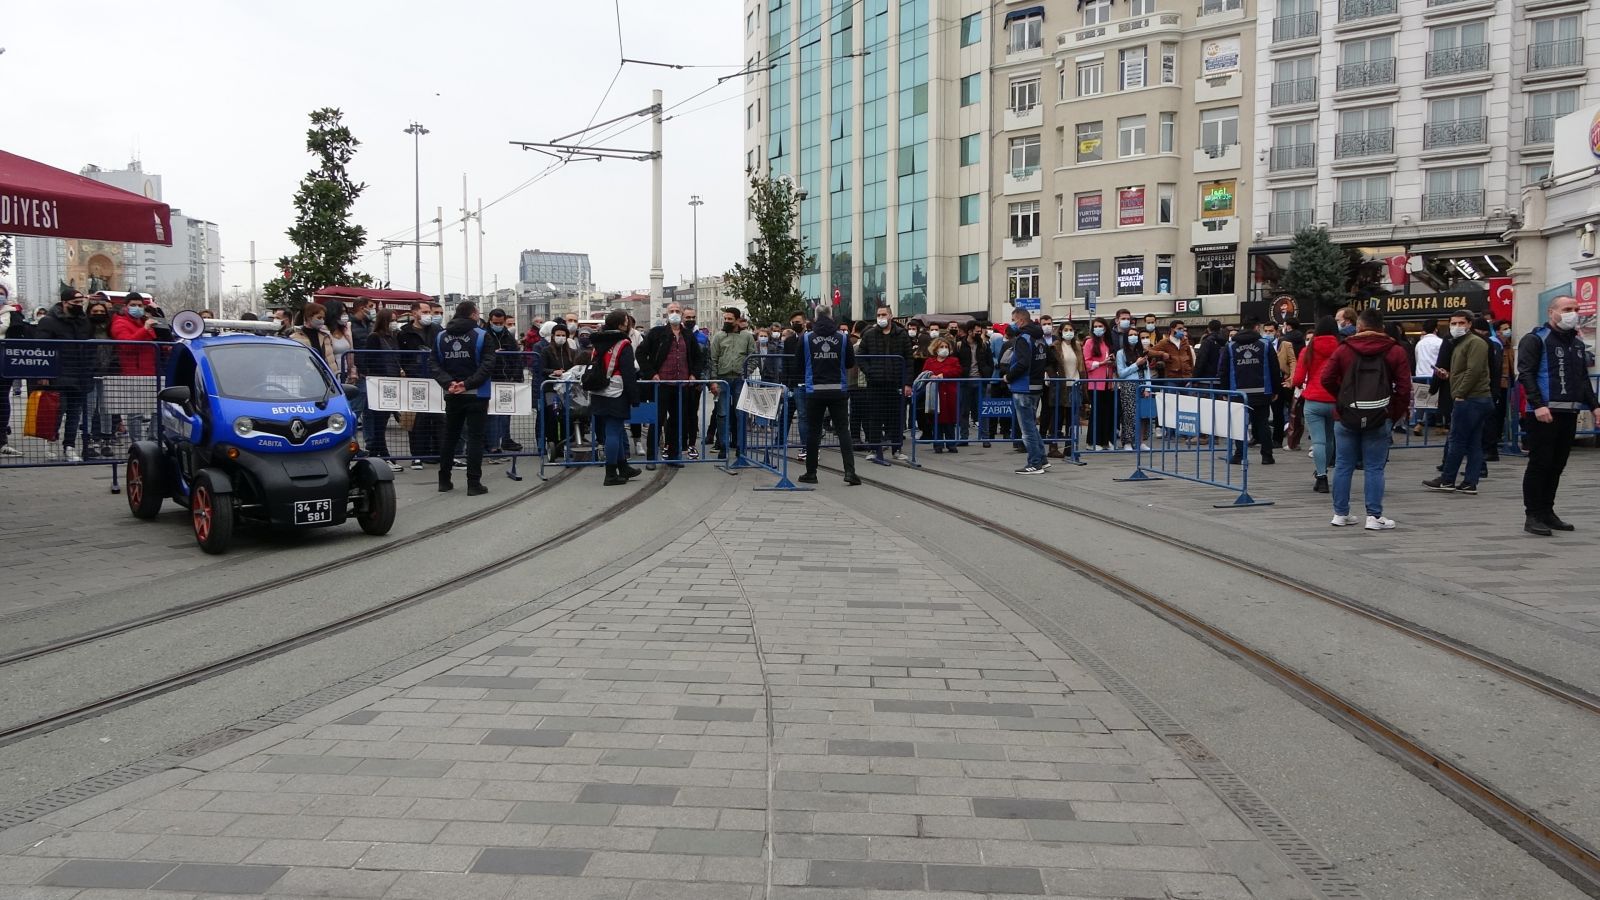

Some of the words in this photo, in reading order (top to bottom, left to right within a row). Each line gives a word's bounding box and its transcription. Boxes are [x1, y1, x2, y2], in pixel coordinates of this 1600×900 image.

[1121, 267, 1140, 275] HAIR
[1387, 296, 1438, 312] MUSTAFA
[1443, 296, 1468, 308] 1864
[5, 347, 56, 357] BEYOĞLU
[10, 358, 50, 366] ZABITA
[271, 405, 315, 415] BEYOĞLU
[981, 406, 1013, 415] ZABITA
[258, 439, 283, 447] ZABITA
[297, 503, 310, 512] 34
[316, 501, 329, 511] FS
[307, 512, 325, 521] 581
